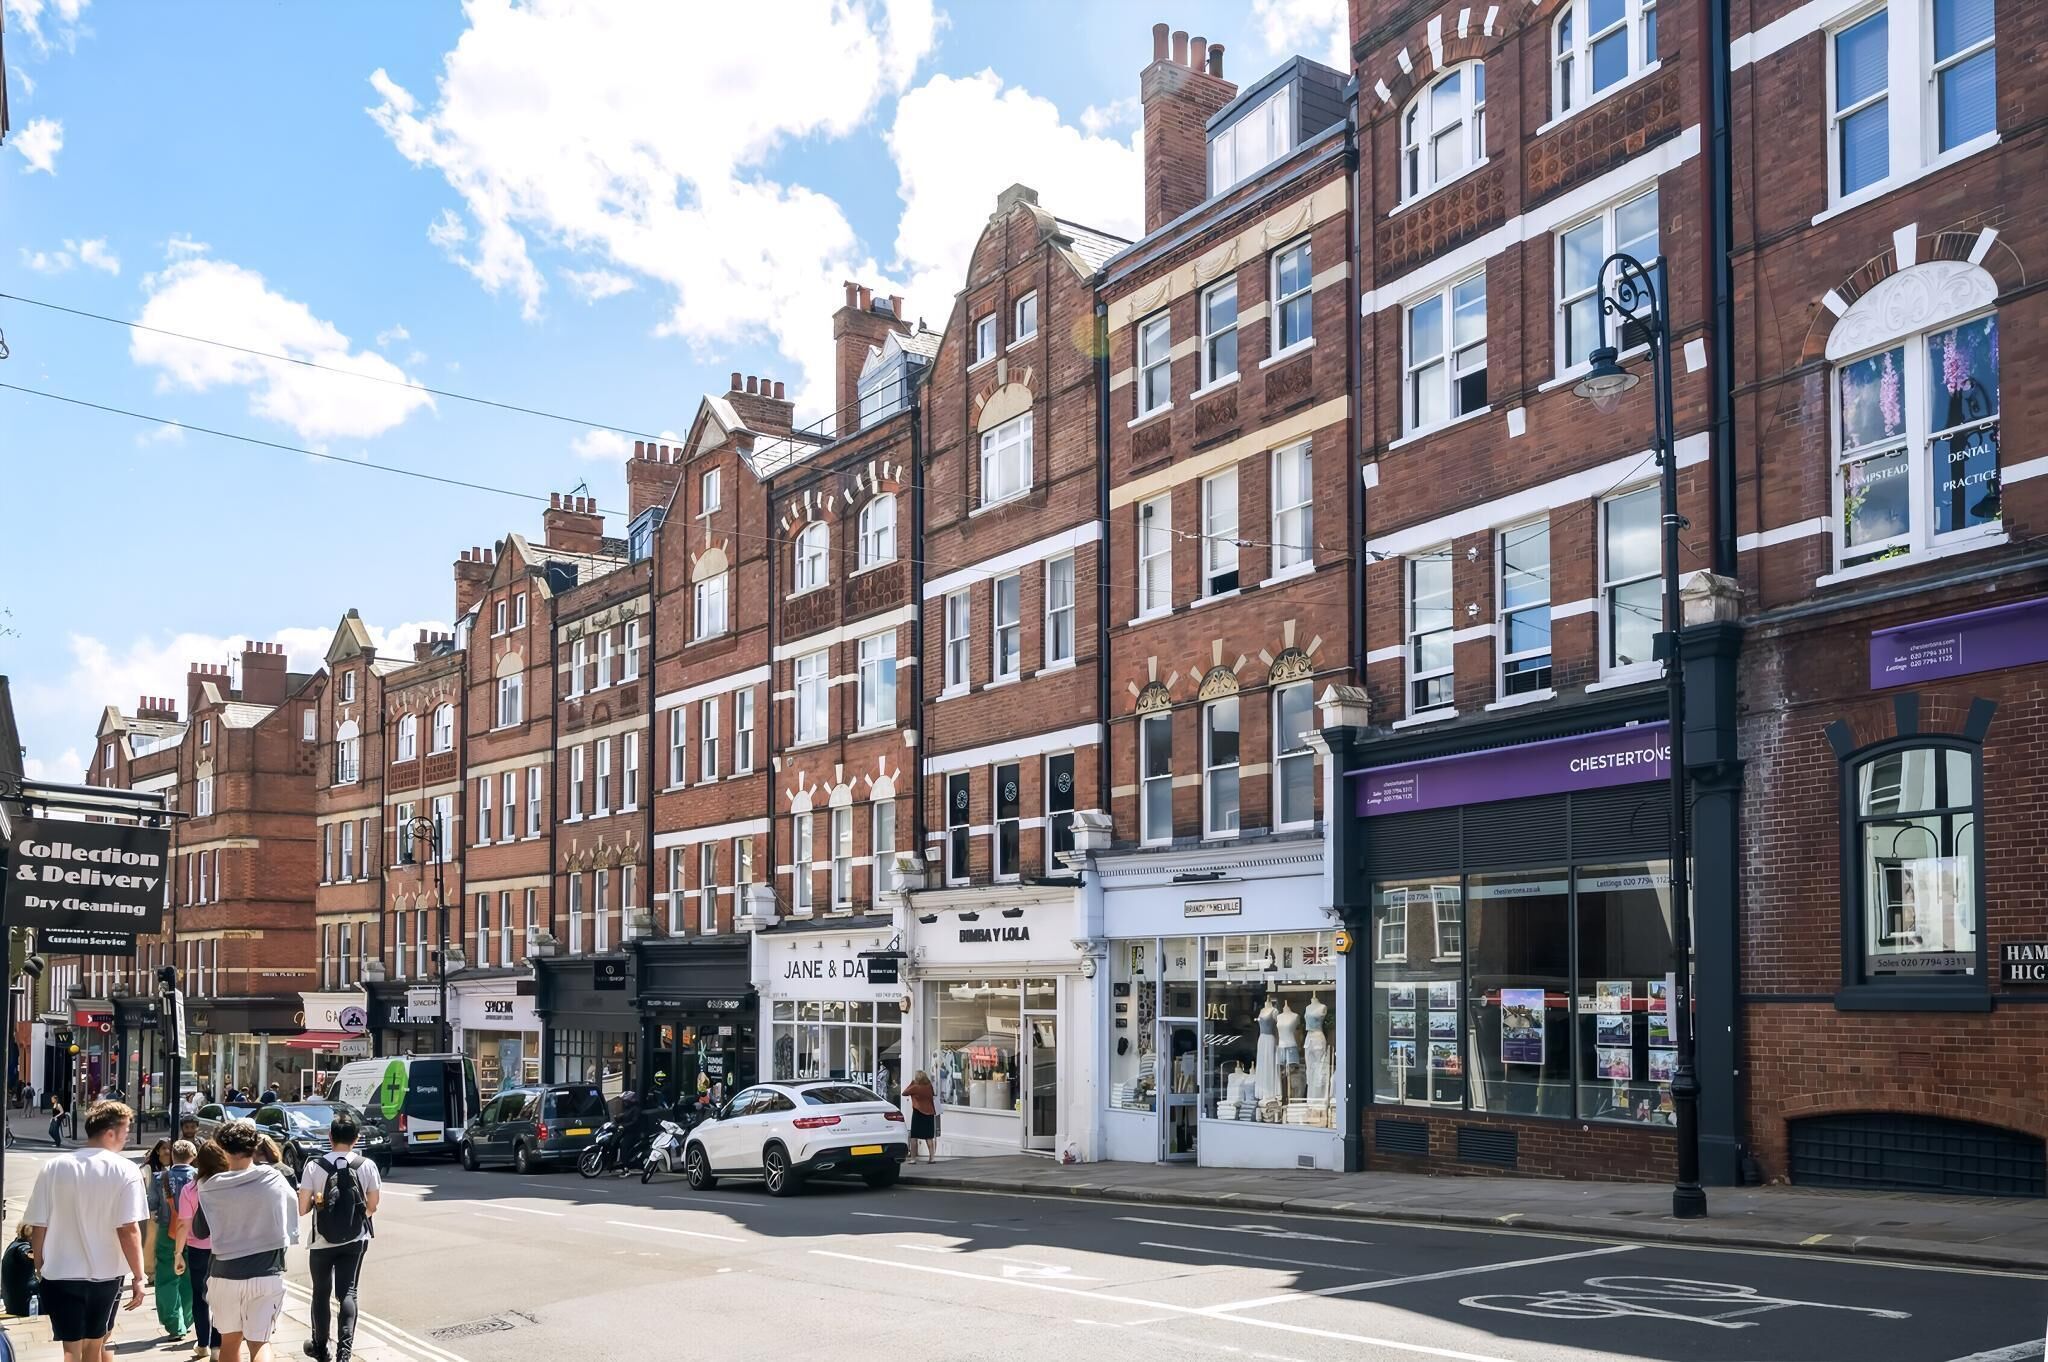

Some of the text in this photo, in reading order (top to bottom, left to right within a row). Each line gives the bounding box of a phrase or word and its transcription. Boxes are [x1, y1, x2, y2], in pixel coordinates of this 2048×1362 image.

[1948, 444, 1991, 464] DENTAL
[1845, 463, 1909, 489] HAMPSTEAD
[1943, 468, 1997, 492] PRACTICE
[1569, 745, 1671, 772] CHESTERTONS
[18, 840, 160, 867] Collection
[15, 864, 159, 892] & Delivery
[24, 895, 147, 916] Dry Cleaning
[48, 935, 127, 947] Curtain Service
[959, 926, 1031, 943] BIMBA Y LOLA
[784, 959, 868, 979] JANE & DA
[1901, 958, 1918, 967] 020
[1920, 957, 1942, 967] 7794
[1944, 957, 1967, 966] 3311
[851, 1071, 873, 1085] SALE
